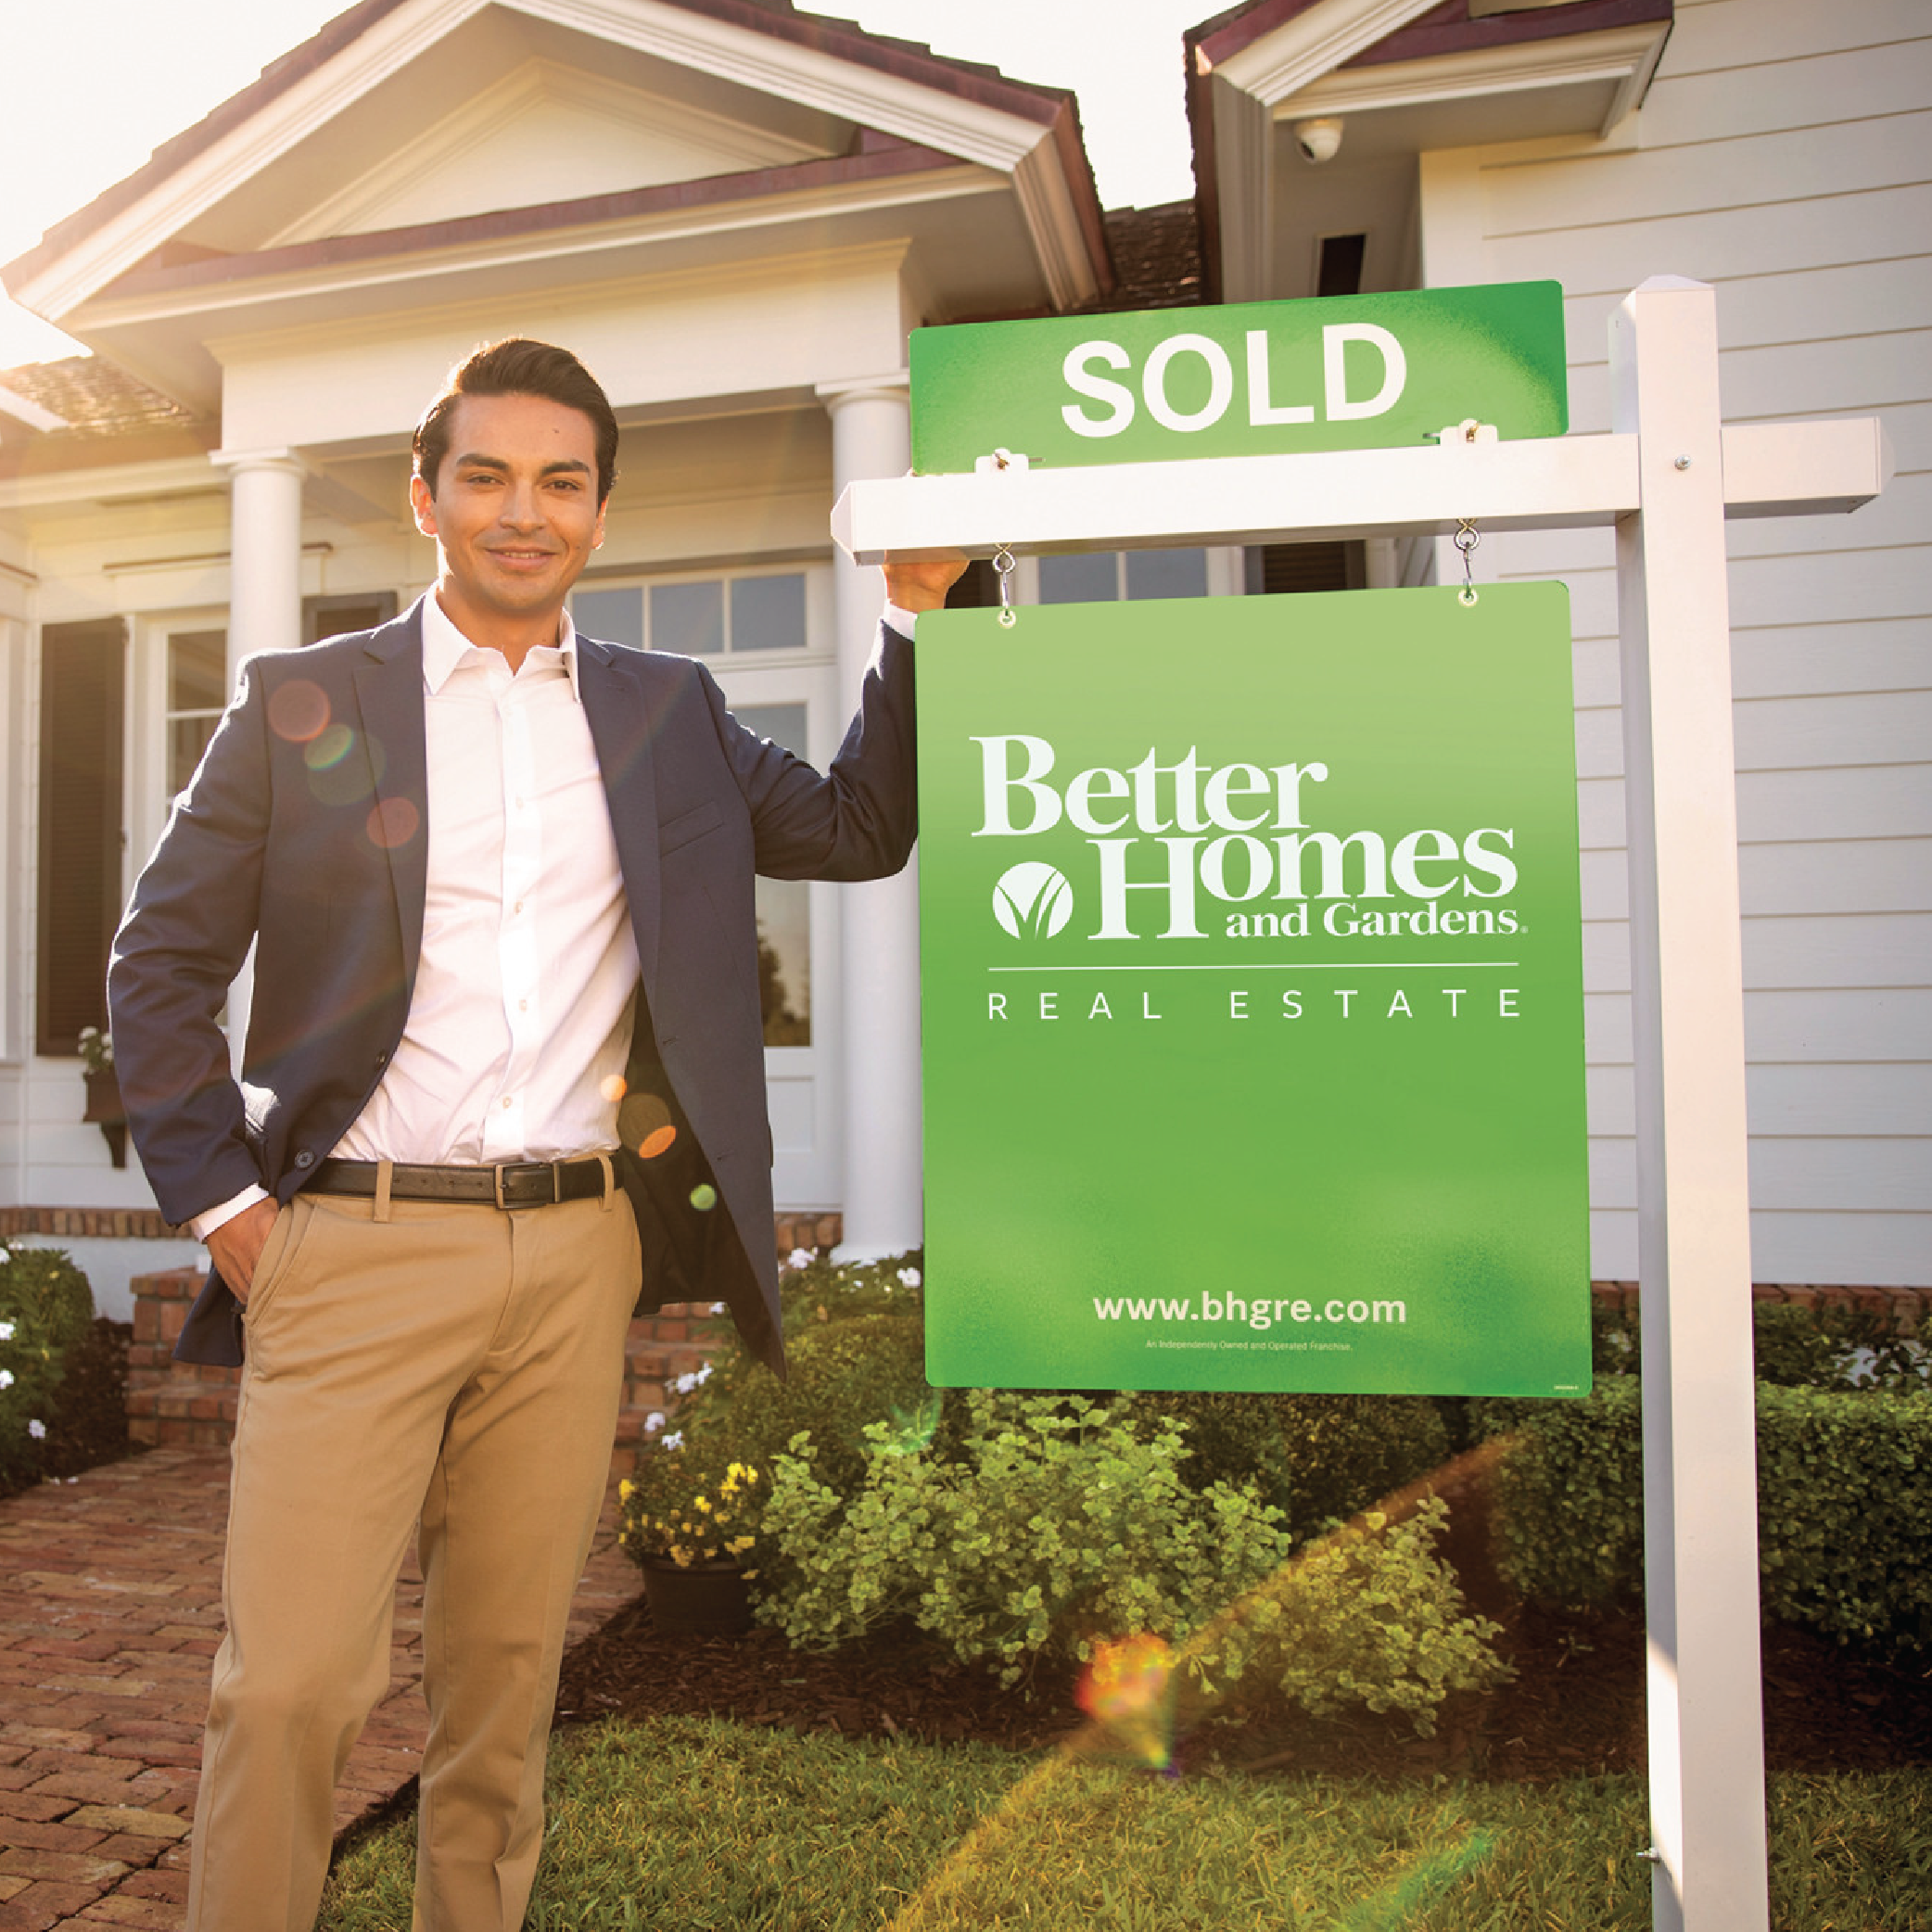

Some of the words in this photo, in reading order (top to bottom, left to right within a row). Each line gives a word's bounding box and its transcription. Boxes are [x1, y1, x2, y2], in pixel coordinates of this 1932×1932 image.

[1061, 323, 1407, 438] SOLD
[969, 734, 1328, 837] Better
[1086, 828, 1519, 941] Homes
[1226, 904, 1312, 938] and
[988, 991, 1163, 1021] REAL
[1230, 988, 1520, 1020] ESTATE
[1093, 1290, 1406, 1330] www.bhgre.com
